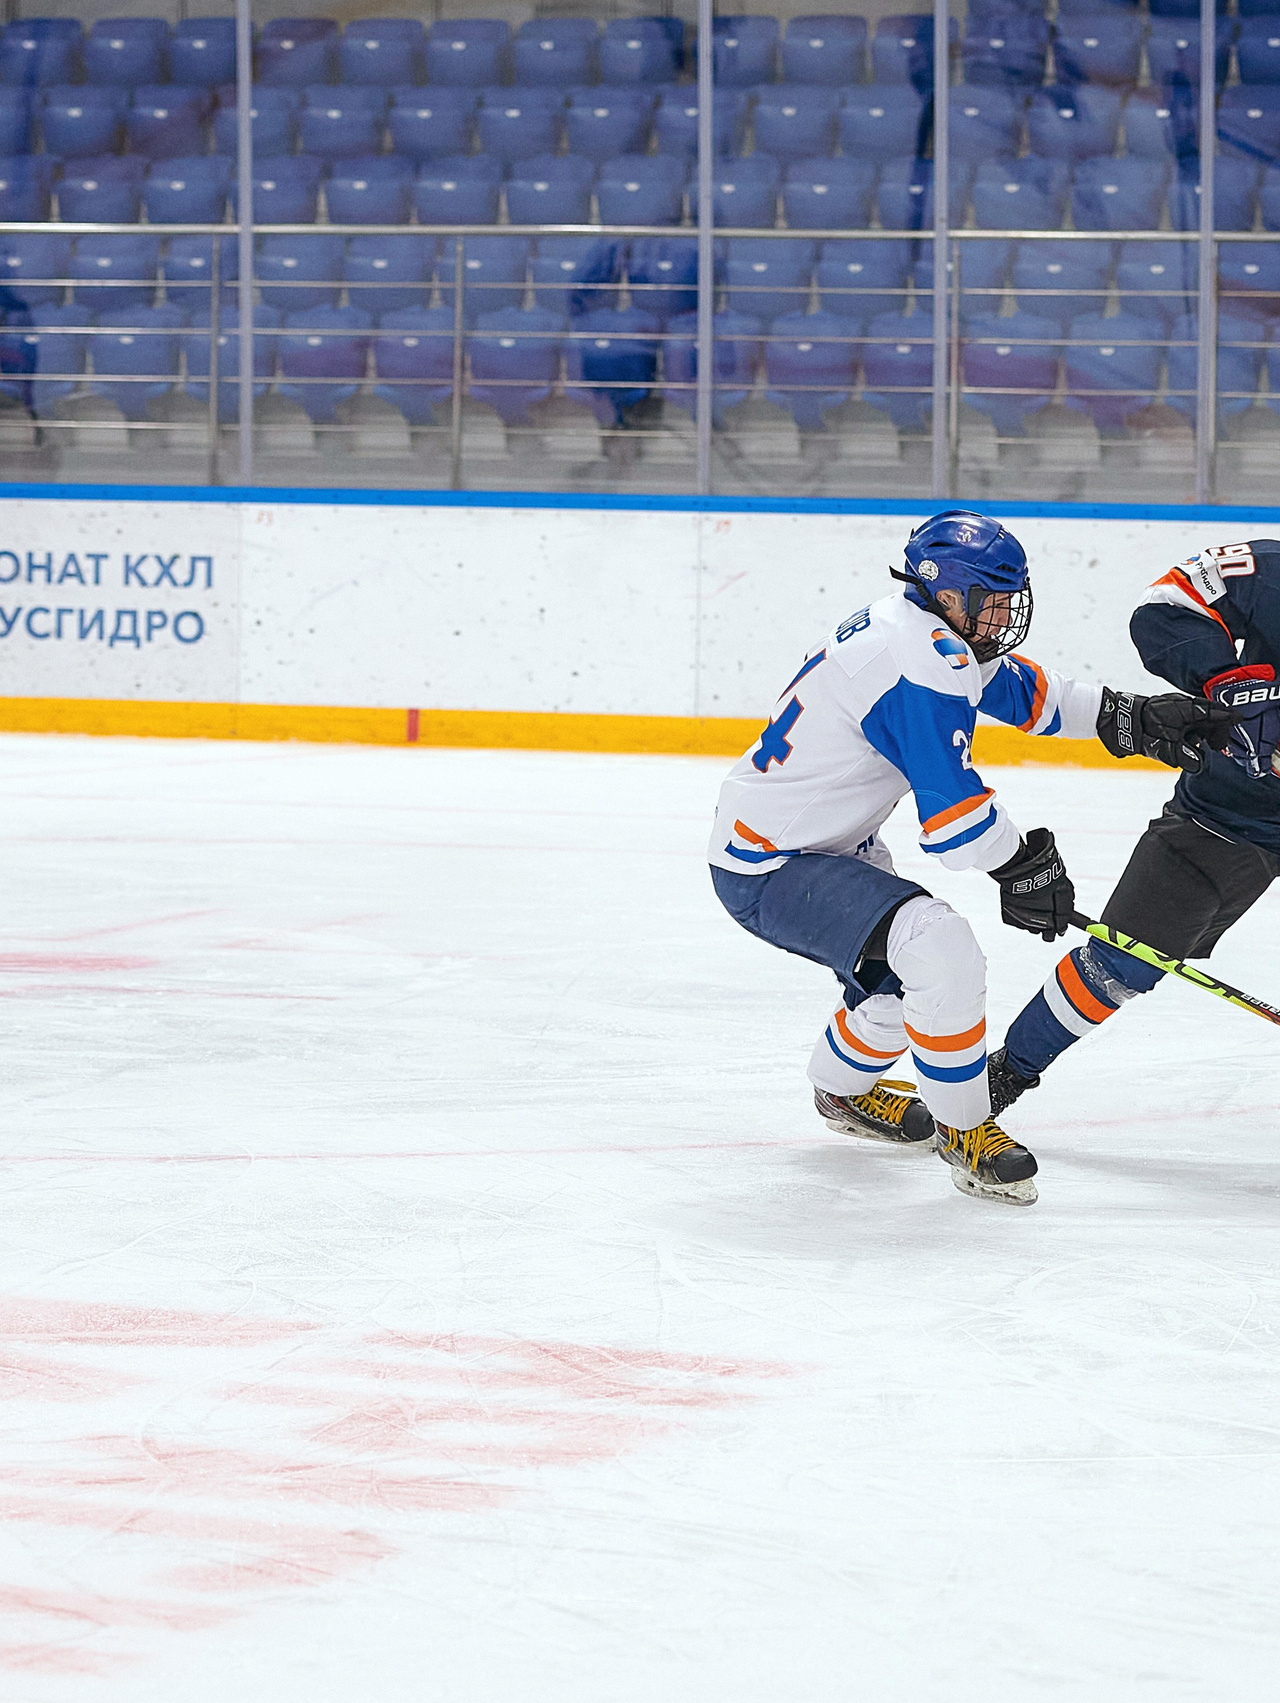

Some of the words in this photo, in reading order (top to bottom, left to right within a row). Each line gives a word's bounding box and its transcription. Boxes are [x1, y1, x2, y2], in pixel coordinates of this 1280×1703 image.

[123, 553, 213, 588] КХЛ
[0, 606, 205, 649] УСГИДРО
[952, 729, 974, 771] 2
